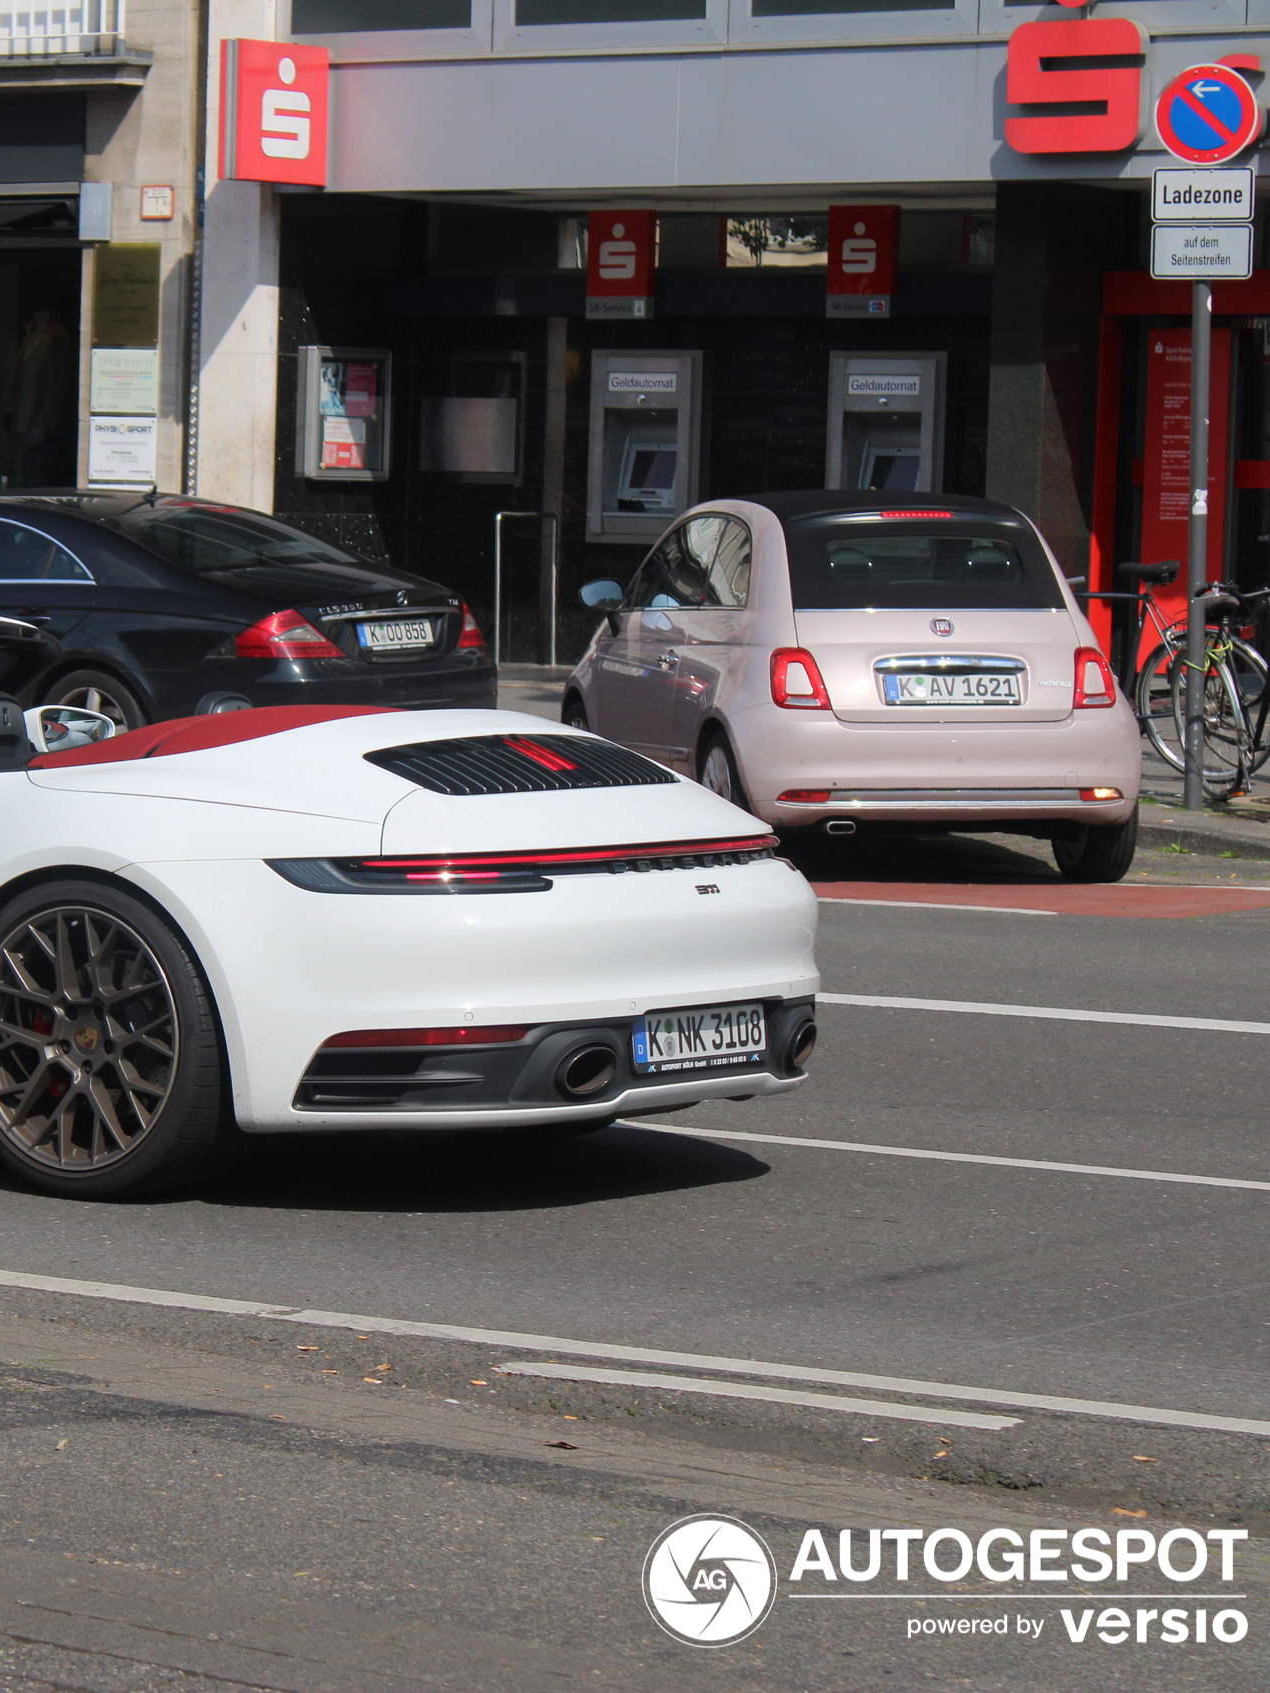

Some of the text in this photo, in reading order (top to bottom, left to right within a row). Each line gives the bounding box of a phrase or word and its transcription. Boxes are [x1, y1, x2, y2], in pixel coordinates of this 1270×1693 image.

[1163, 184, 1243, 205] Ladezone
[1184, 235, 1219, 248] auf dem
[1170, 253, 1231, 267] Seitenstreifen
[588, 303, 632, 313] SB-Service
[611, 375, 674, 389] Geldautomat
[851, 379, 917, 393] Geldautomat
[368, 624, 381, 643] K
[404, 622, 428, 641] 858
[935, 620, 950, 631] FIAT
[899, 677, 1017, 697] K AV 1621
[609, 851, 751, 874] PORSCHE
[647, 1009, 762, 1057] K NK 3108
